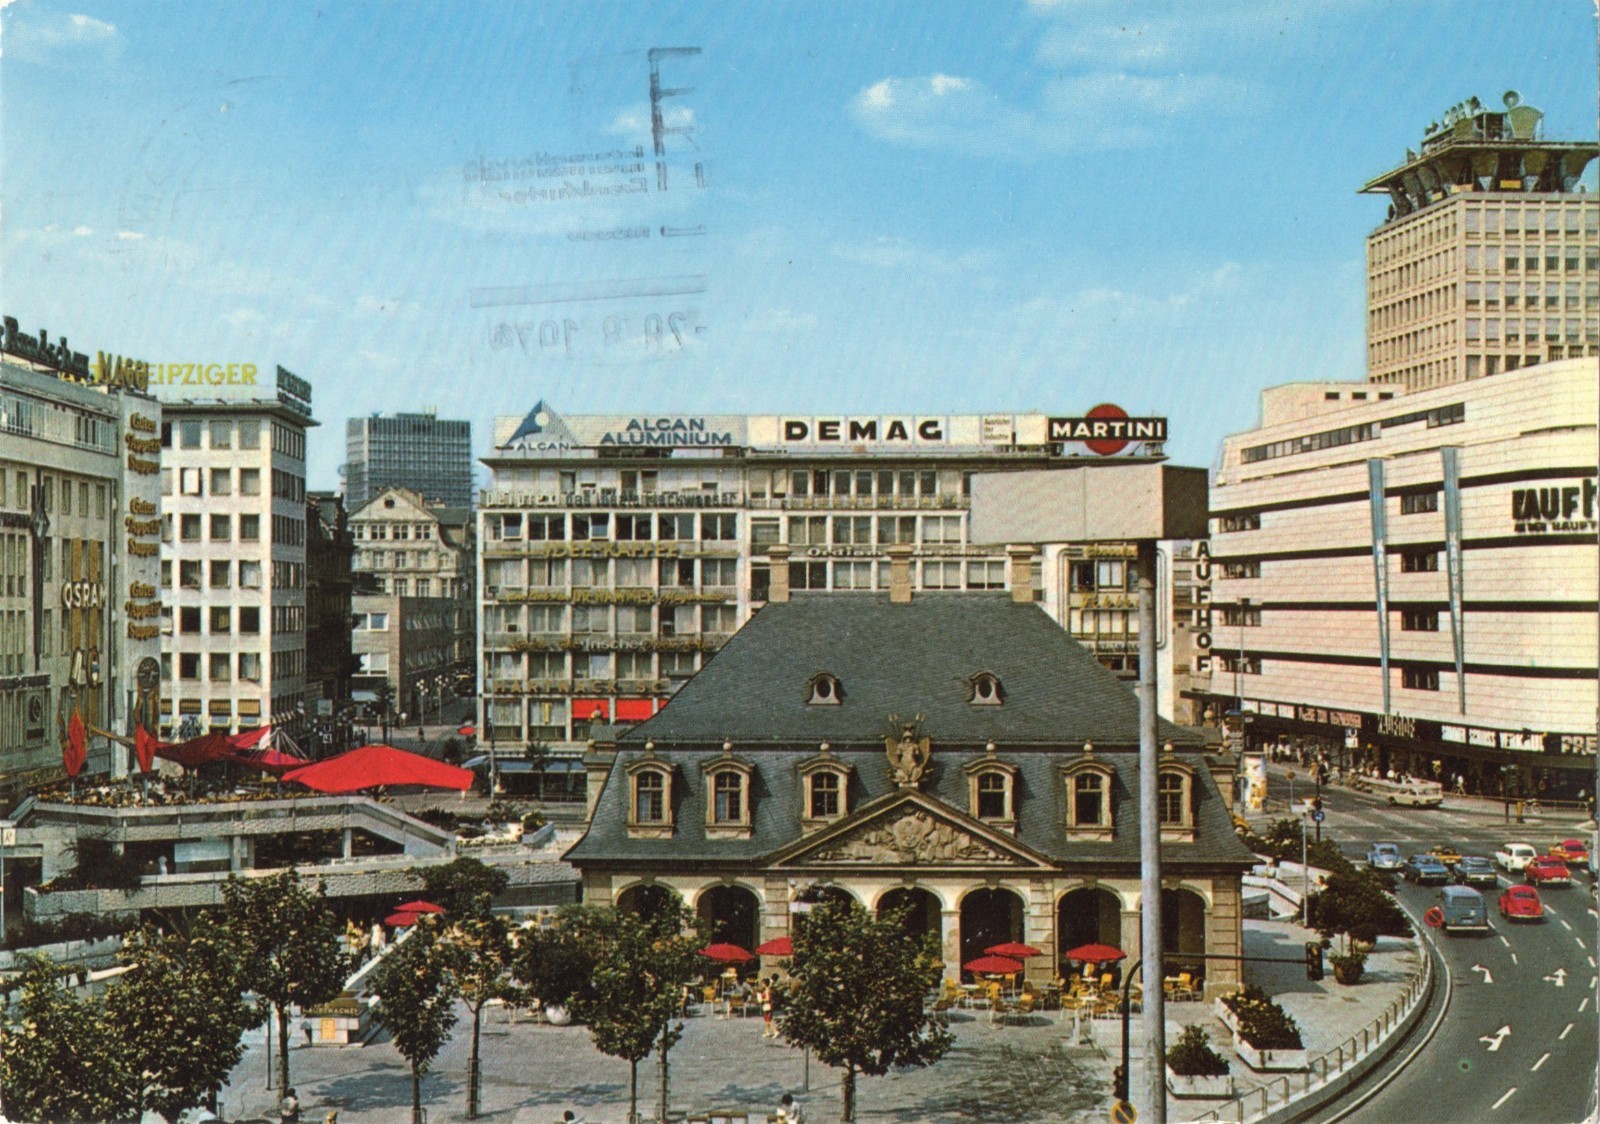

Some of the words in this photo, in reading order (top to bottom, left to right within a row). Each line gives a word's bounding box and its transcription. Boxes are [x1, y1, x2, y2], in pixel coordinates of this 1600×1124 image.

[147, 363, 258, 386] EIPZIGER
[626, 418, 705, 432] ALCAN
[785, 420, 943, 441] DEMAG
[1052, 421, 1163, 438] MARTINI
[516, 441, 571, 451] ALCAN
[600, 432, 732, 446] ALUMINIUM
[1196, 541, 1212, 671] AUFHOF
